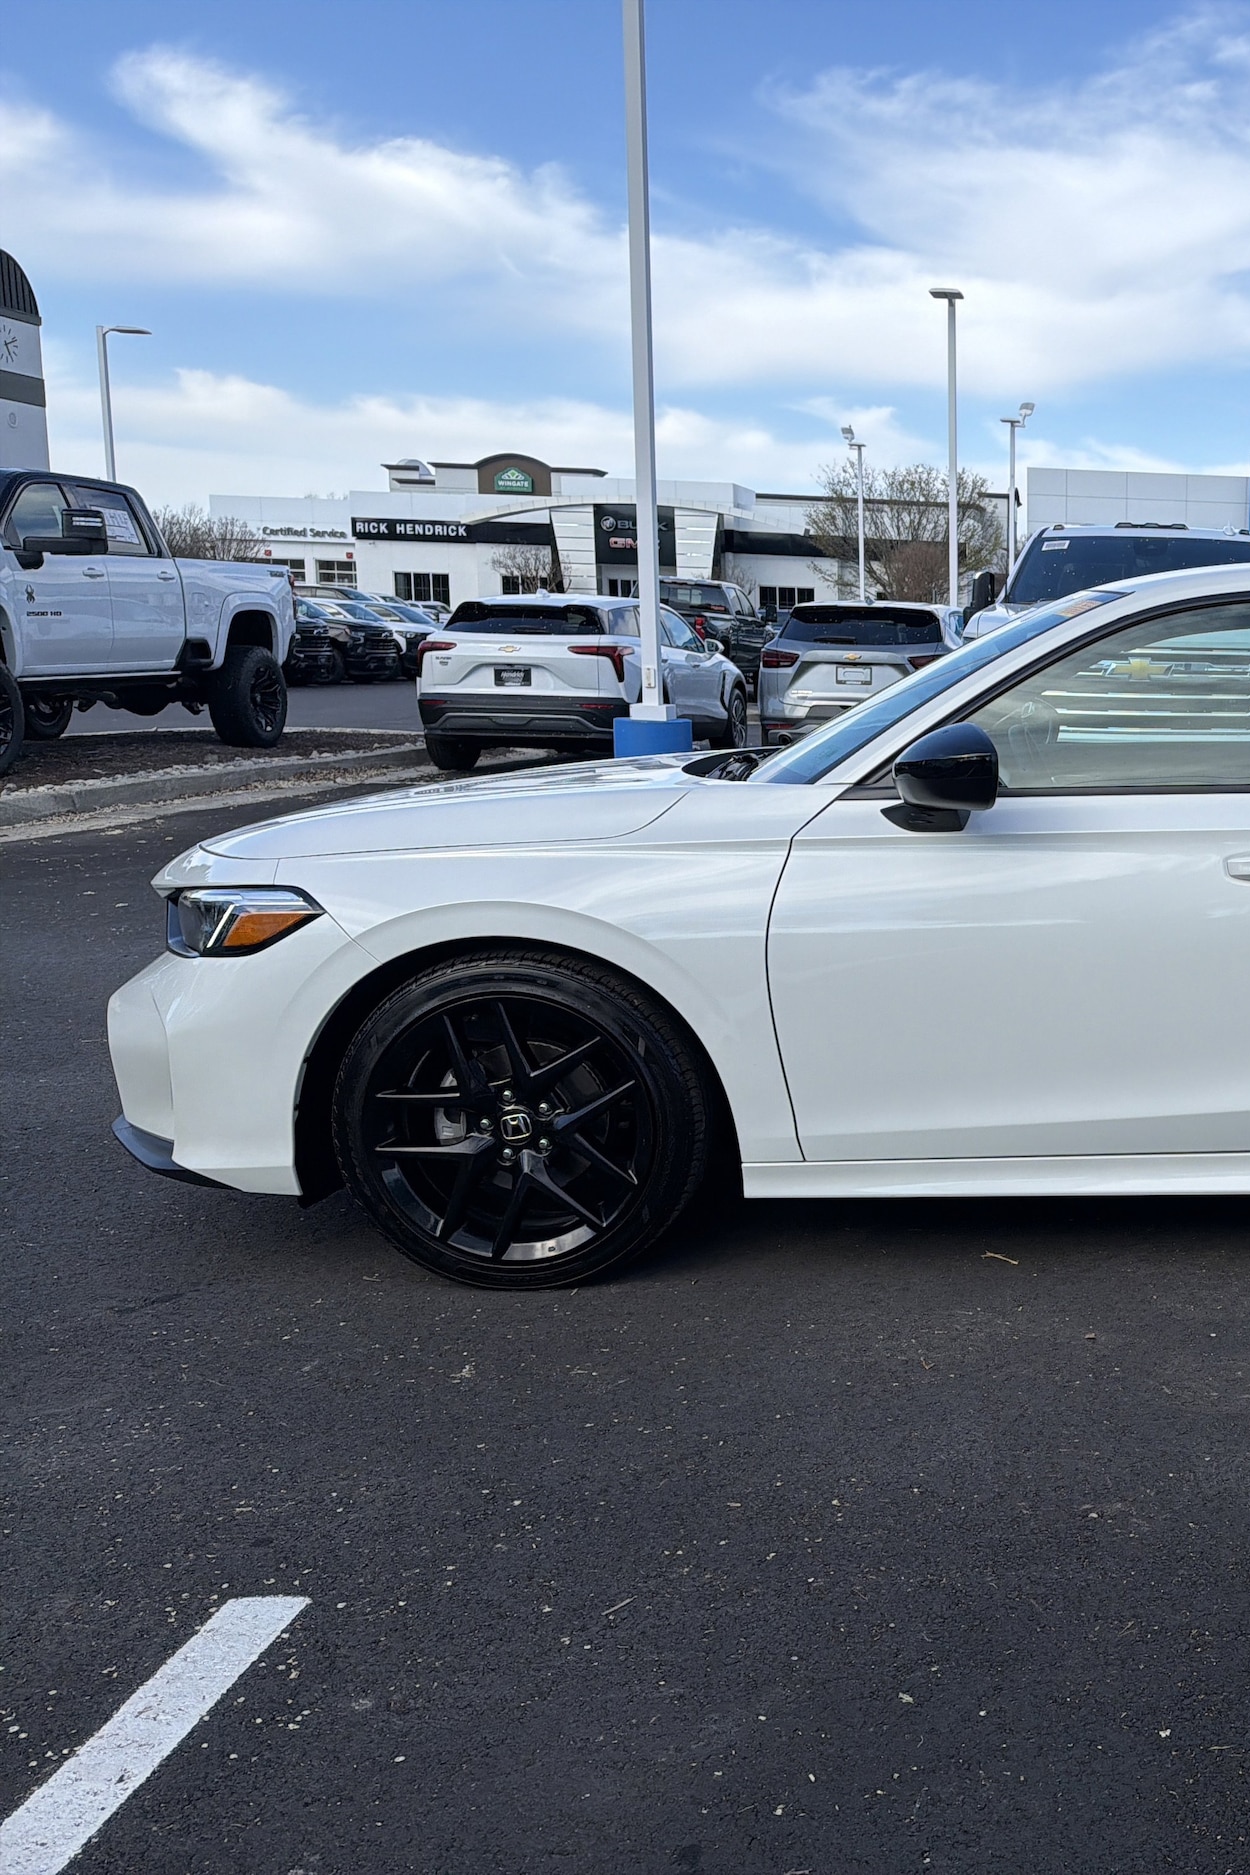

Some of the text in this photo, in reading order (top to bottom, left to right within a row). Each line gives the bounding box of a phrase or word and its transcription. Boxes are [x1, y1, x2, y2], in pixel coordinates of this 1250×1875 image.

[355, 522, 468, 537] RICK HENDRICK
[617, 520, 668, 531] BUK
[262, 526, 348, 539] Certified Service
[609, 537, 660, 549] GM
